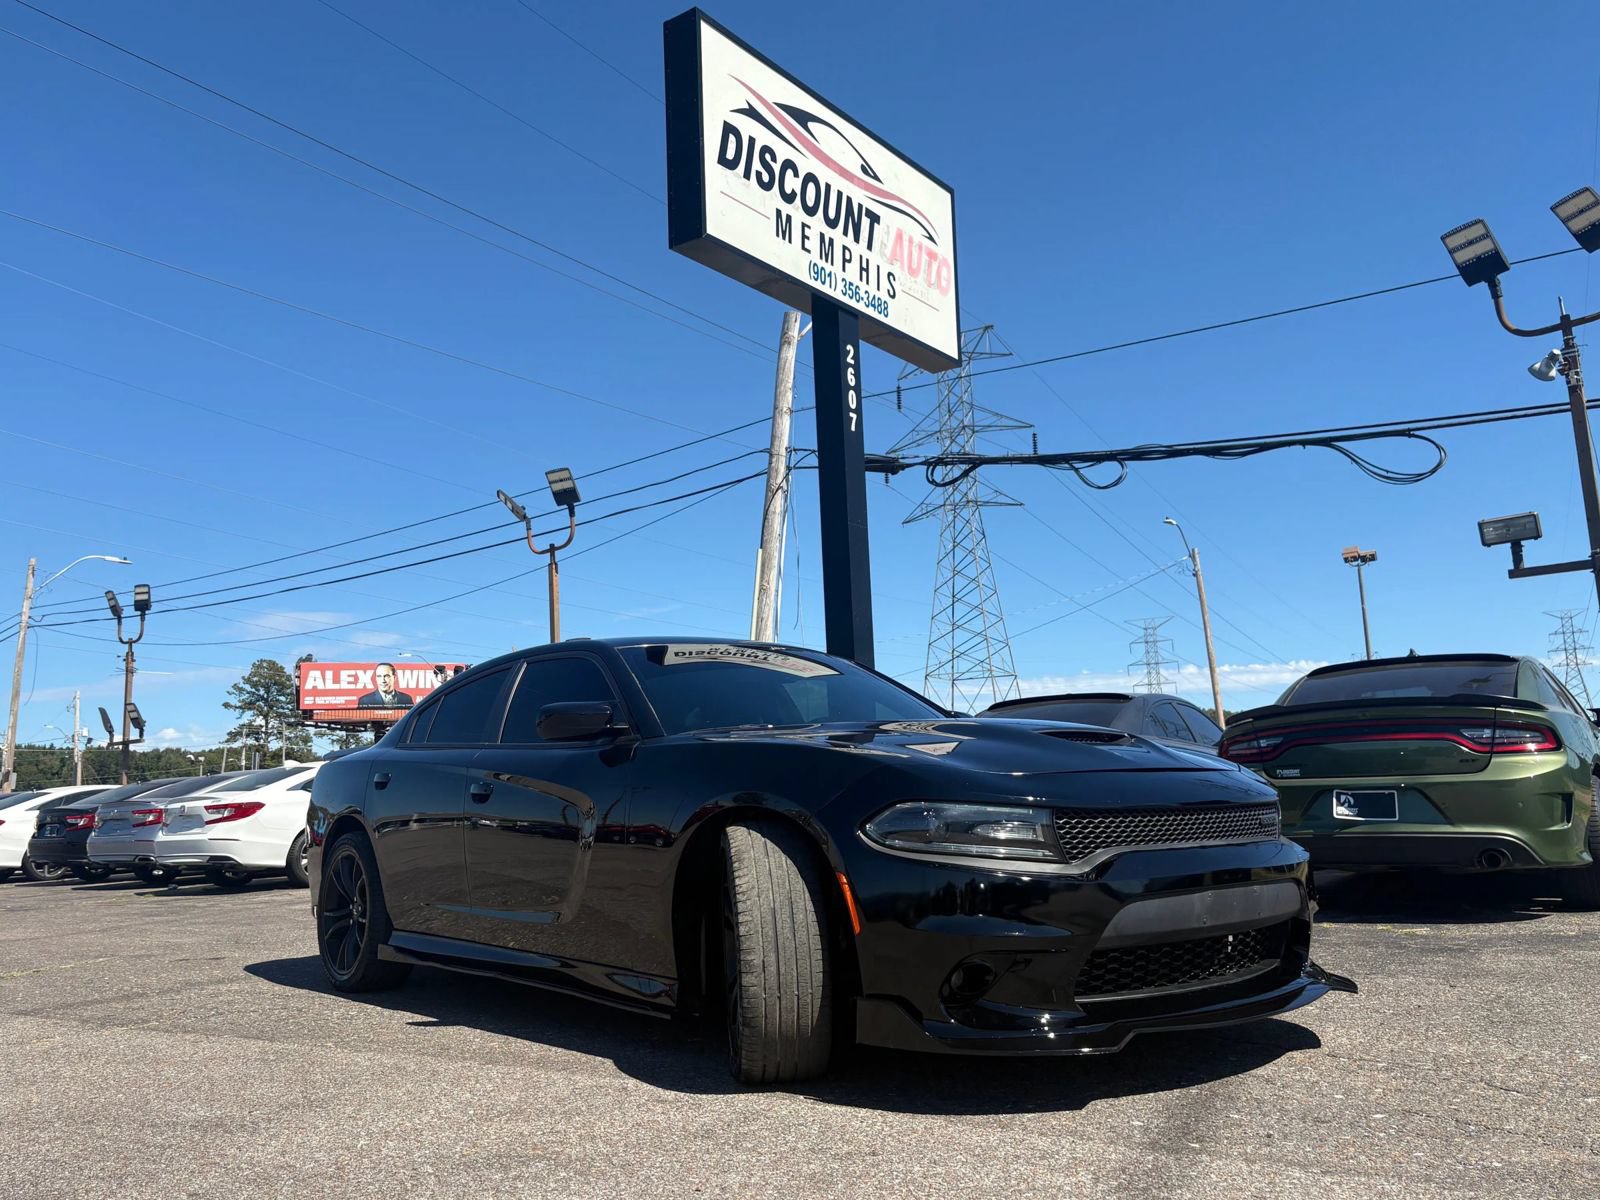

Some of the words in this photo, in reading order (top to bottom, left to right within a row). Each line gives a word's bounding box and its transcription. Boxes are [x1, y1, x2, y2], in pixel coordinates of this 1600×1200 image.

[717, 119, 881, 252] DISCOUNT
[886, 226, 952, 297] AUTO
[775, 207, 896, 300] MEMPHIS
[808, 259, 838, 292] (901)
[840, 277, 889, 318] 356-3488
[846, 343, 857, 432] 2607
[304, 669, 375, 690] ALEX
[396, 669, 455, 689] WIN
